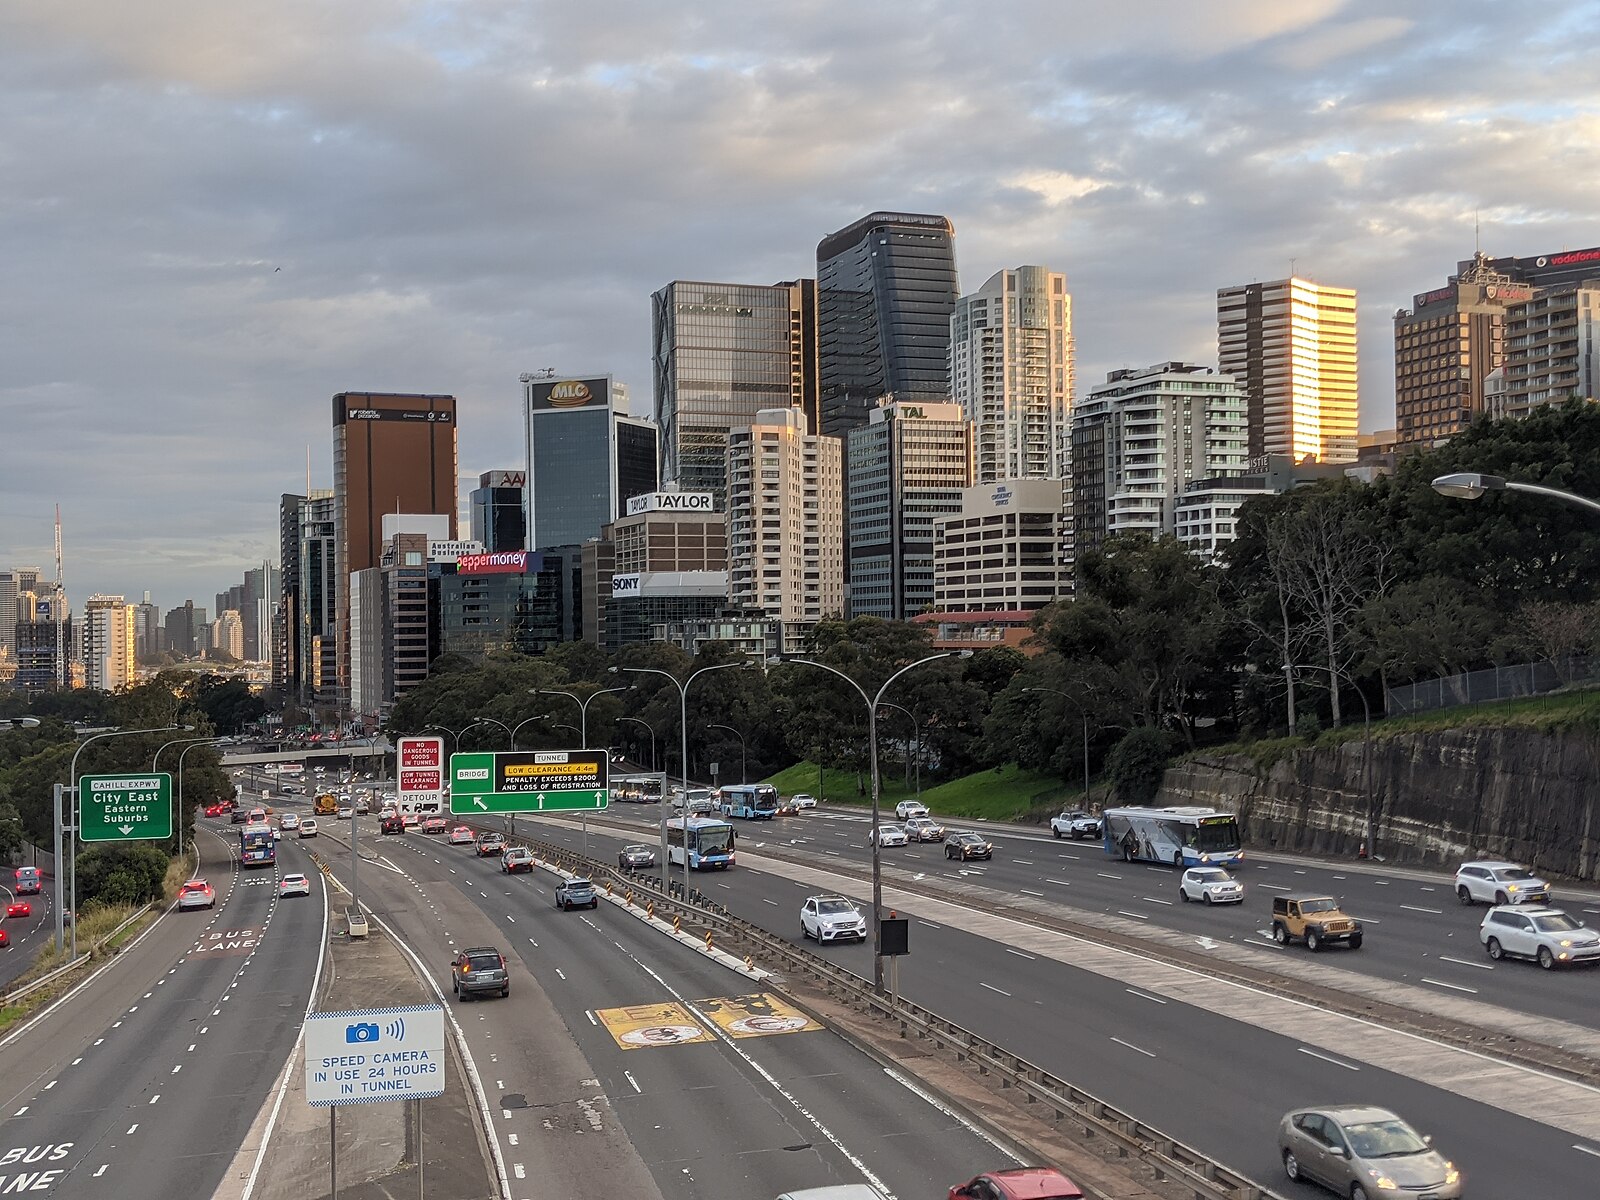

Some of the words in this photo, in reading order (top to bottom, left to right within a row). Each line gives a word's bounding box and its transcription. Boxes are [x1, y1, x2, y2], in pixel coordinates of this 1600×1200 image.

[1551, 251, 1600, 265] vodafone
[554, 384, 585, 398] MLC
[901, 406, 928, 419] TAL
[630, 496, 648, 512] TAYLOR
[655, 495, 710, 508] TAYLOR
[432, 542, 476, 550] Australian
[457, 552, 527, 571] peppermoney
[612, 577, 640, 591] SONY
[459, 770, 487, 778] BRIDGE
[93, 781, 126, 789] CAHILL
[128, 780, 158, 788] EXPWY
[519, 783, 538, 791] LOSS
[93, 792, 121, 805] City
[128, 791, 158, 802] East
[402, 794, 438, 802] DETOUR
[104, 804, 147, 813] Eastern
[103, 814, 149, 823] Suburbs
[209, 930, 253, 940] BUS
[196, 940, 255, 952] LANE
[322, 1055, 365, 1068] SPEED
[373, 1050, 429, 1064] CAMERA
[314, 1072, 327, 1083] IN
[334, 1069, 360, 1081] USE
[368, 1067, 385, 1078] 24
[393, 1063, 437, 1076] HOURS
[341, 1084, 353, 1094] IN
[361, 1079, 412, 1093] TUNNEL
[0, 1142, 75, 1166] BUS
[0, 1169, 65, 1194] NE
